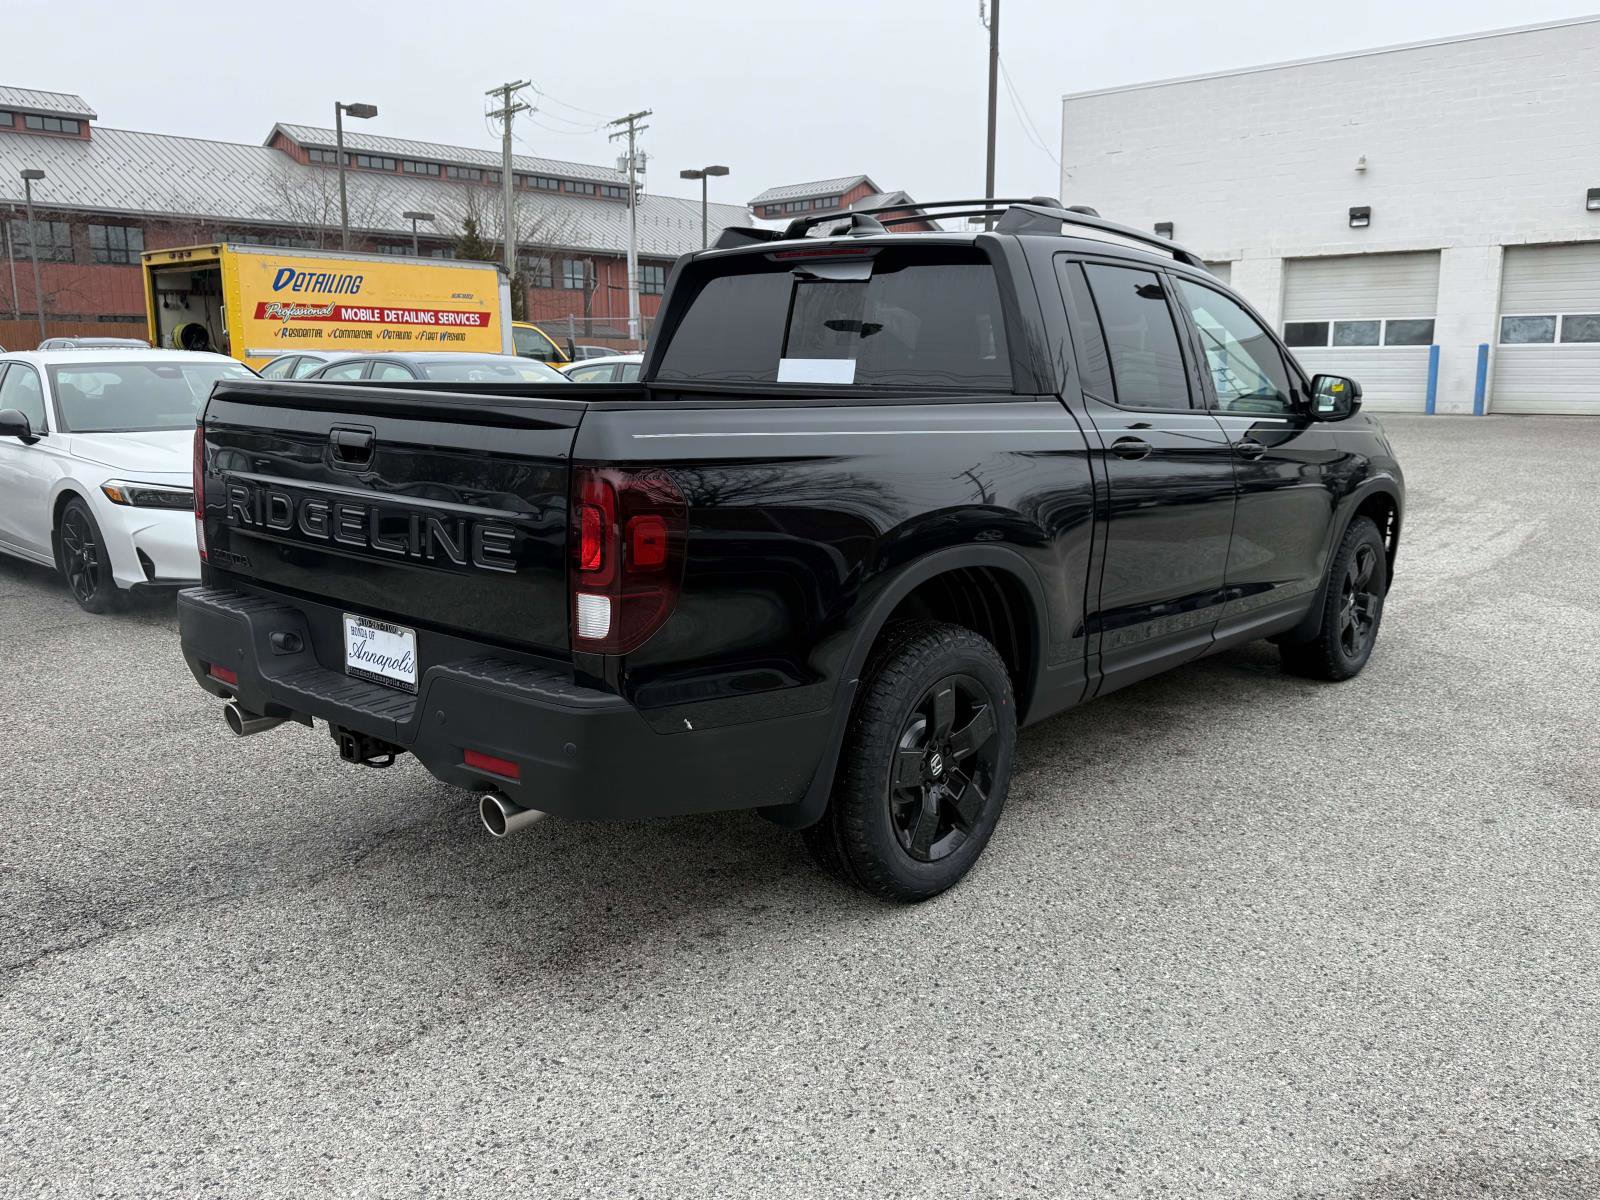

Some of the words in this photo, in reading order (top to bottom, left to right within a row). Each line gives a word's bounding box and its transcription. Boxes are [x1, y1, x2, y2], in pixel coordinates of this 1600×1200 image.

[264, 301, 335, 324] Professional
[341, 307, 380, 321] MOBILE
[384, 310, 435, 323] DETAILING
[438, 313, 480, 325] SERVICES
[226, 482, 518, 575] RIDGELINE
[350, 625, 368, 639] HONDA
[349, 640, 415, 674] Annapolis
